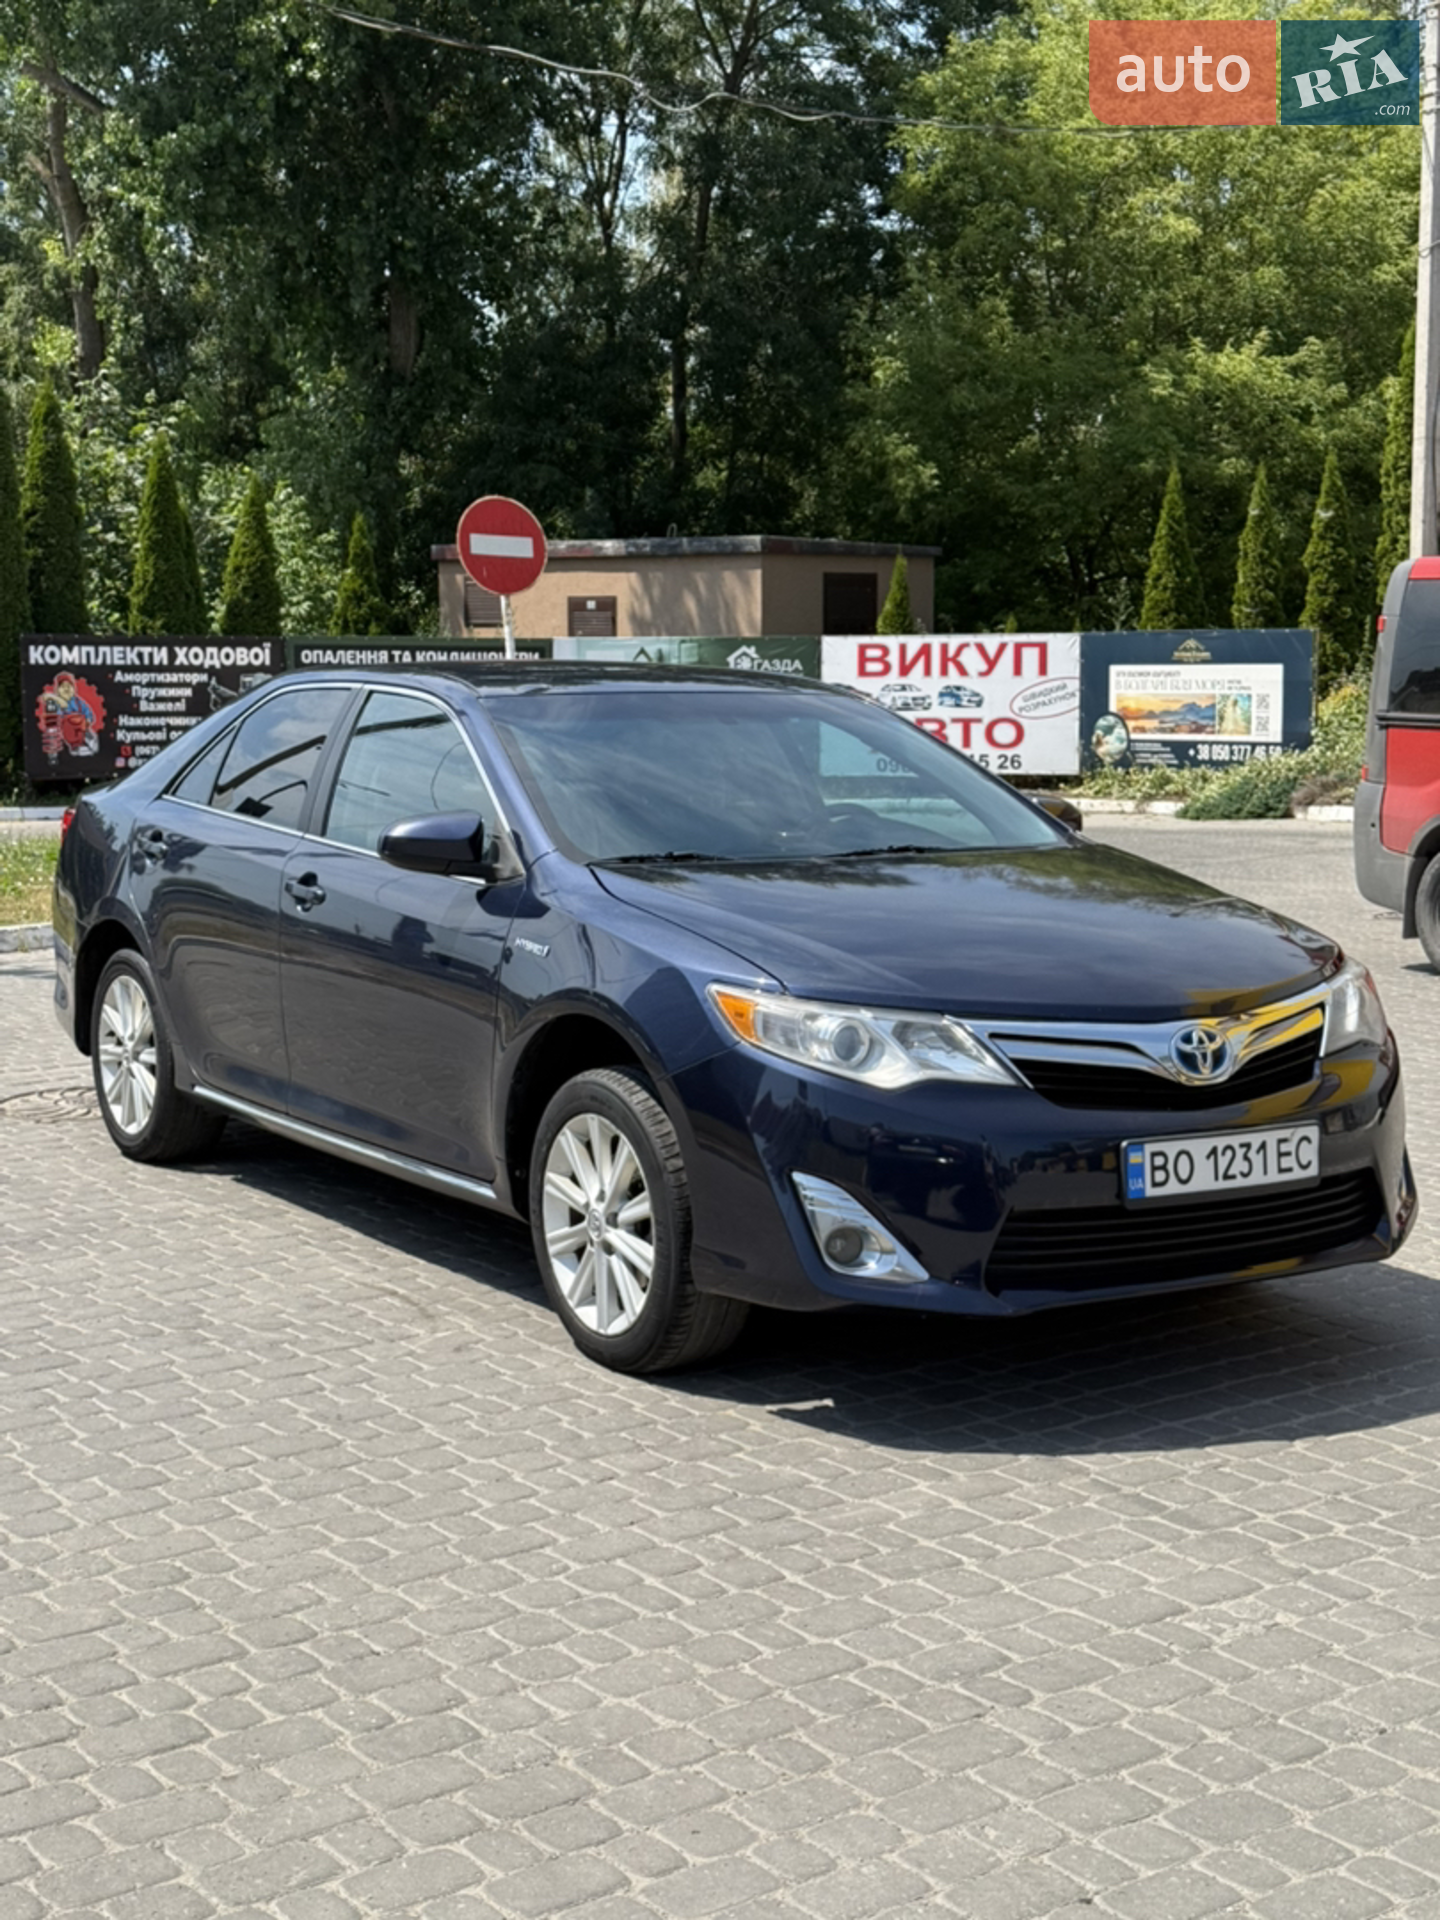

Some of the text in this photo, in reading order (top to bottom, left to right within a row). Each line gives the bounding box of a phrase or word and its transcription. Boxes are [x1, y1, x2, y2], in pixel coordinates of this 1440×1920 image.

[28, 642, 271, 669] КОМПЛЕКТИ ХОДОВОЇ
[301, 649, 388, 665] ОПАЛЕННЯ
[391, 650, 411, 664] ТА
[857, 641, 1048, 678] ВИКУП
[753, 658, 804, 673] ГАЗДА
[114, 671, 208, 685] Амортизатори
[131, 685, 192, 701] Пружини
[1021, 682, 1068, 703] ШВИДКИЙ
[139, 701, 186, 712] Важелі
[1018, 691, 1077, 714] РОЗРАХУНОК
[116, 728, 167, 743] Кульові
[997, 753, 1022, 770] 26
[1150, 1135, 1313, 1189] BO 1231 EC
[1128, 1177, 1144, 1190] UA
